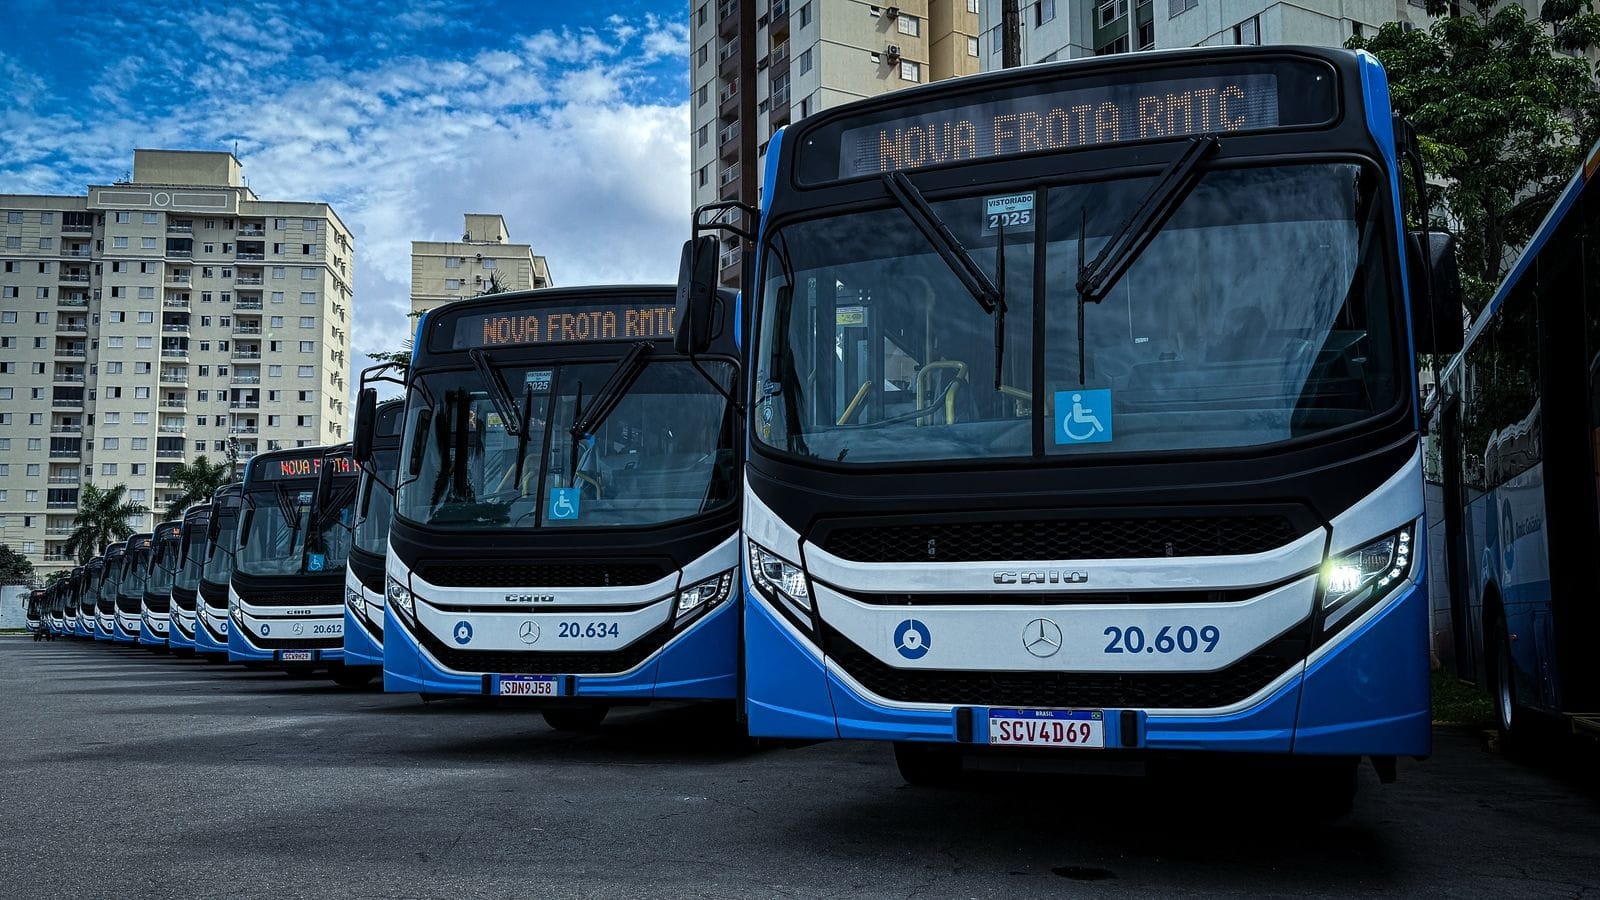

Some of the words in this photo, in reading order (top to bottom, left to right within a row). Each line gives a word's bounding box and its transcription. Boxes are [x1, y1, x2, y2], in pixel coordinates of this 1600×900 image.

[879, 118, 975, 172] NOVA
[993, 102, 1120, 156] FROTA
[1138, 85, 1246, 139] RMTC
[988, 195, 1032, 207] VISTORIADO
[483, 315, 539, 345] NOVA
[547, 311, 616, 342] FROTA
[280, 459, 310, 476] NOVA
[313, 457, 350, 474] FTA
[993, 570, 1088, 585] CAIO
[505, 594, 554, 602] CAIO
[313, 624, 342, 634] 20.612
[558, 622, 619, 638] 20.634
[1103, 624, 1221, 654] 20.609
[504, 681, 552, 695] SDN9J58
[999, 720, 1091, 744] SCV4D69
